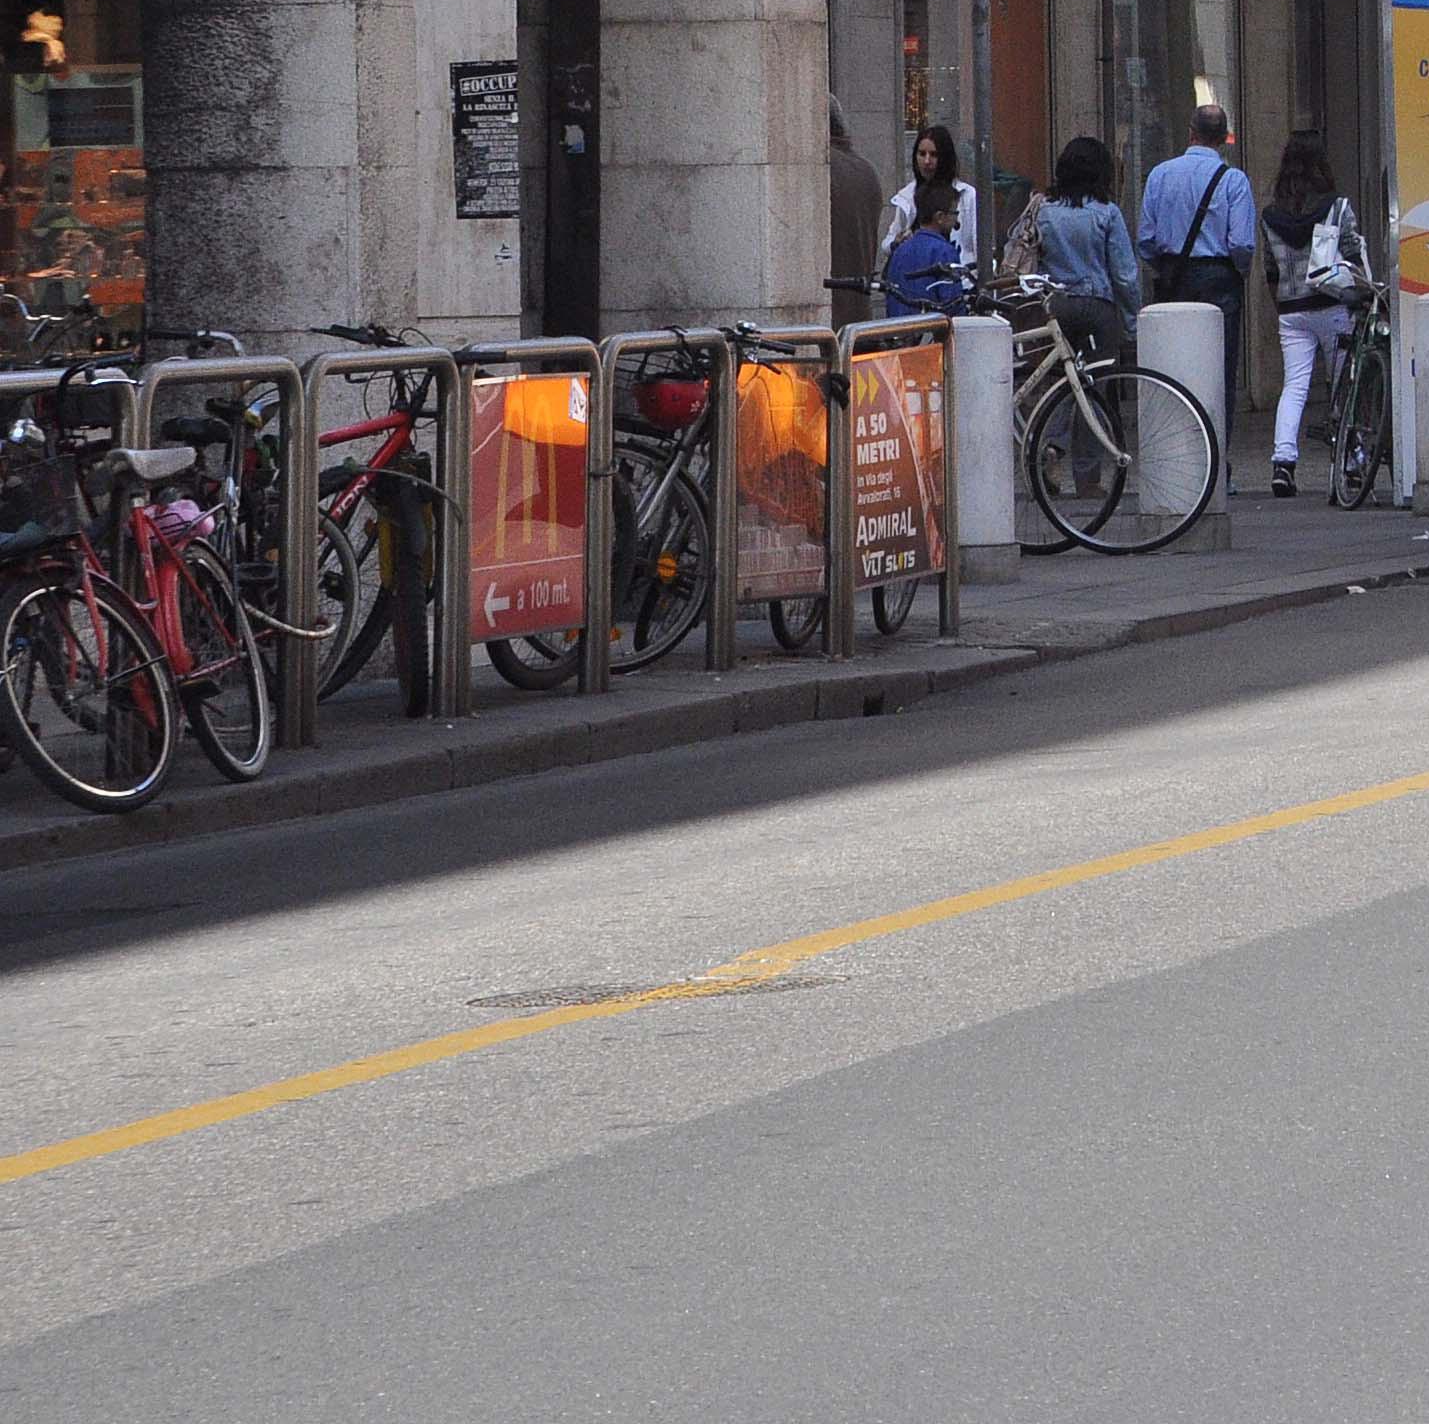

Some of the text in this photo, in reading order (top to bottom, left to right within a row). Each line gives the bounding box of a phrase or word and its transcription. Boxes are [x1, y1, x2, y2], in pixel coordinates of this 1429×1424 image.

[856, 415, 867, 438] A
[856, 437, 901, 467] METRI
[855, 505, 918, 548] ADMIRAL
[517, 590, 525, 612] a
[530, 579, 550, 610] 100
